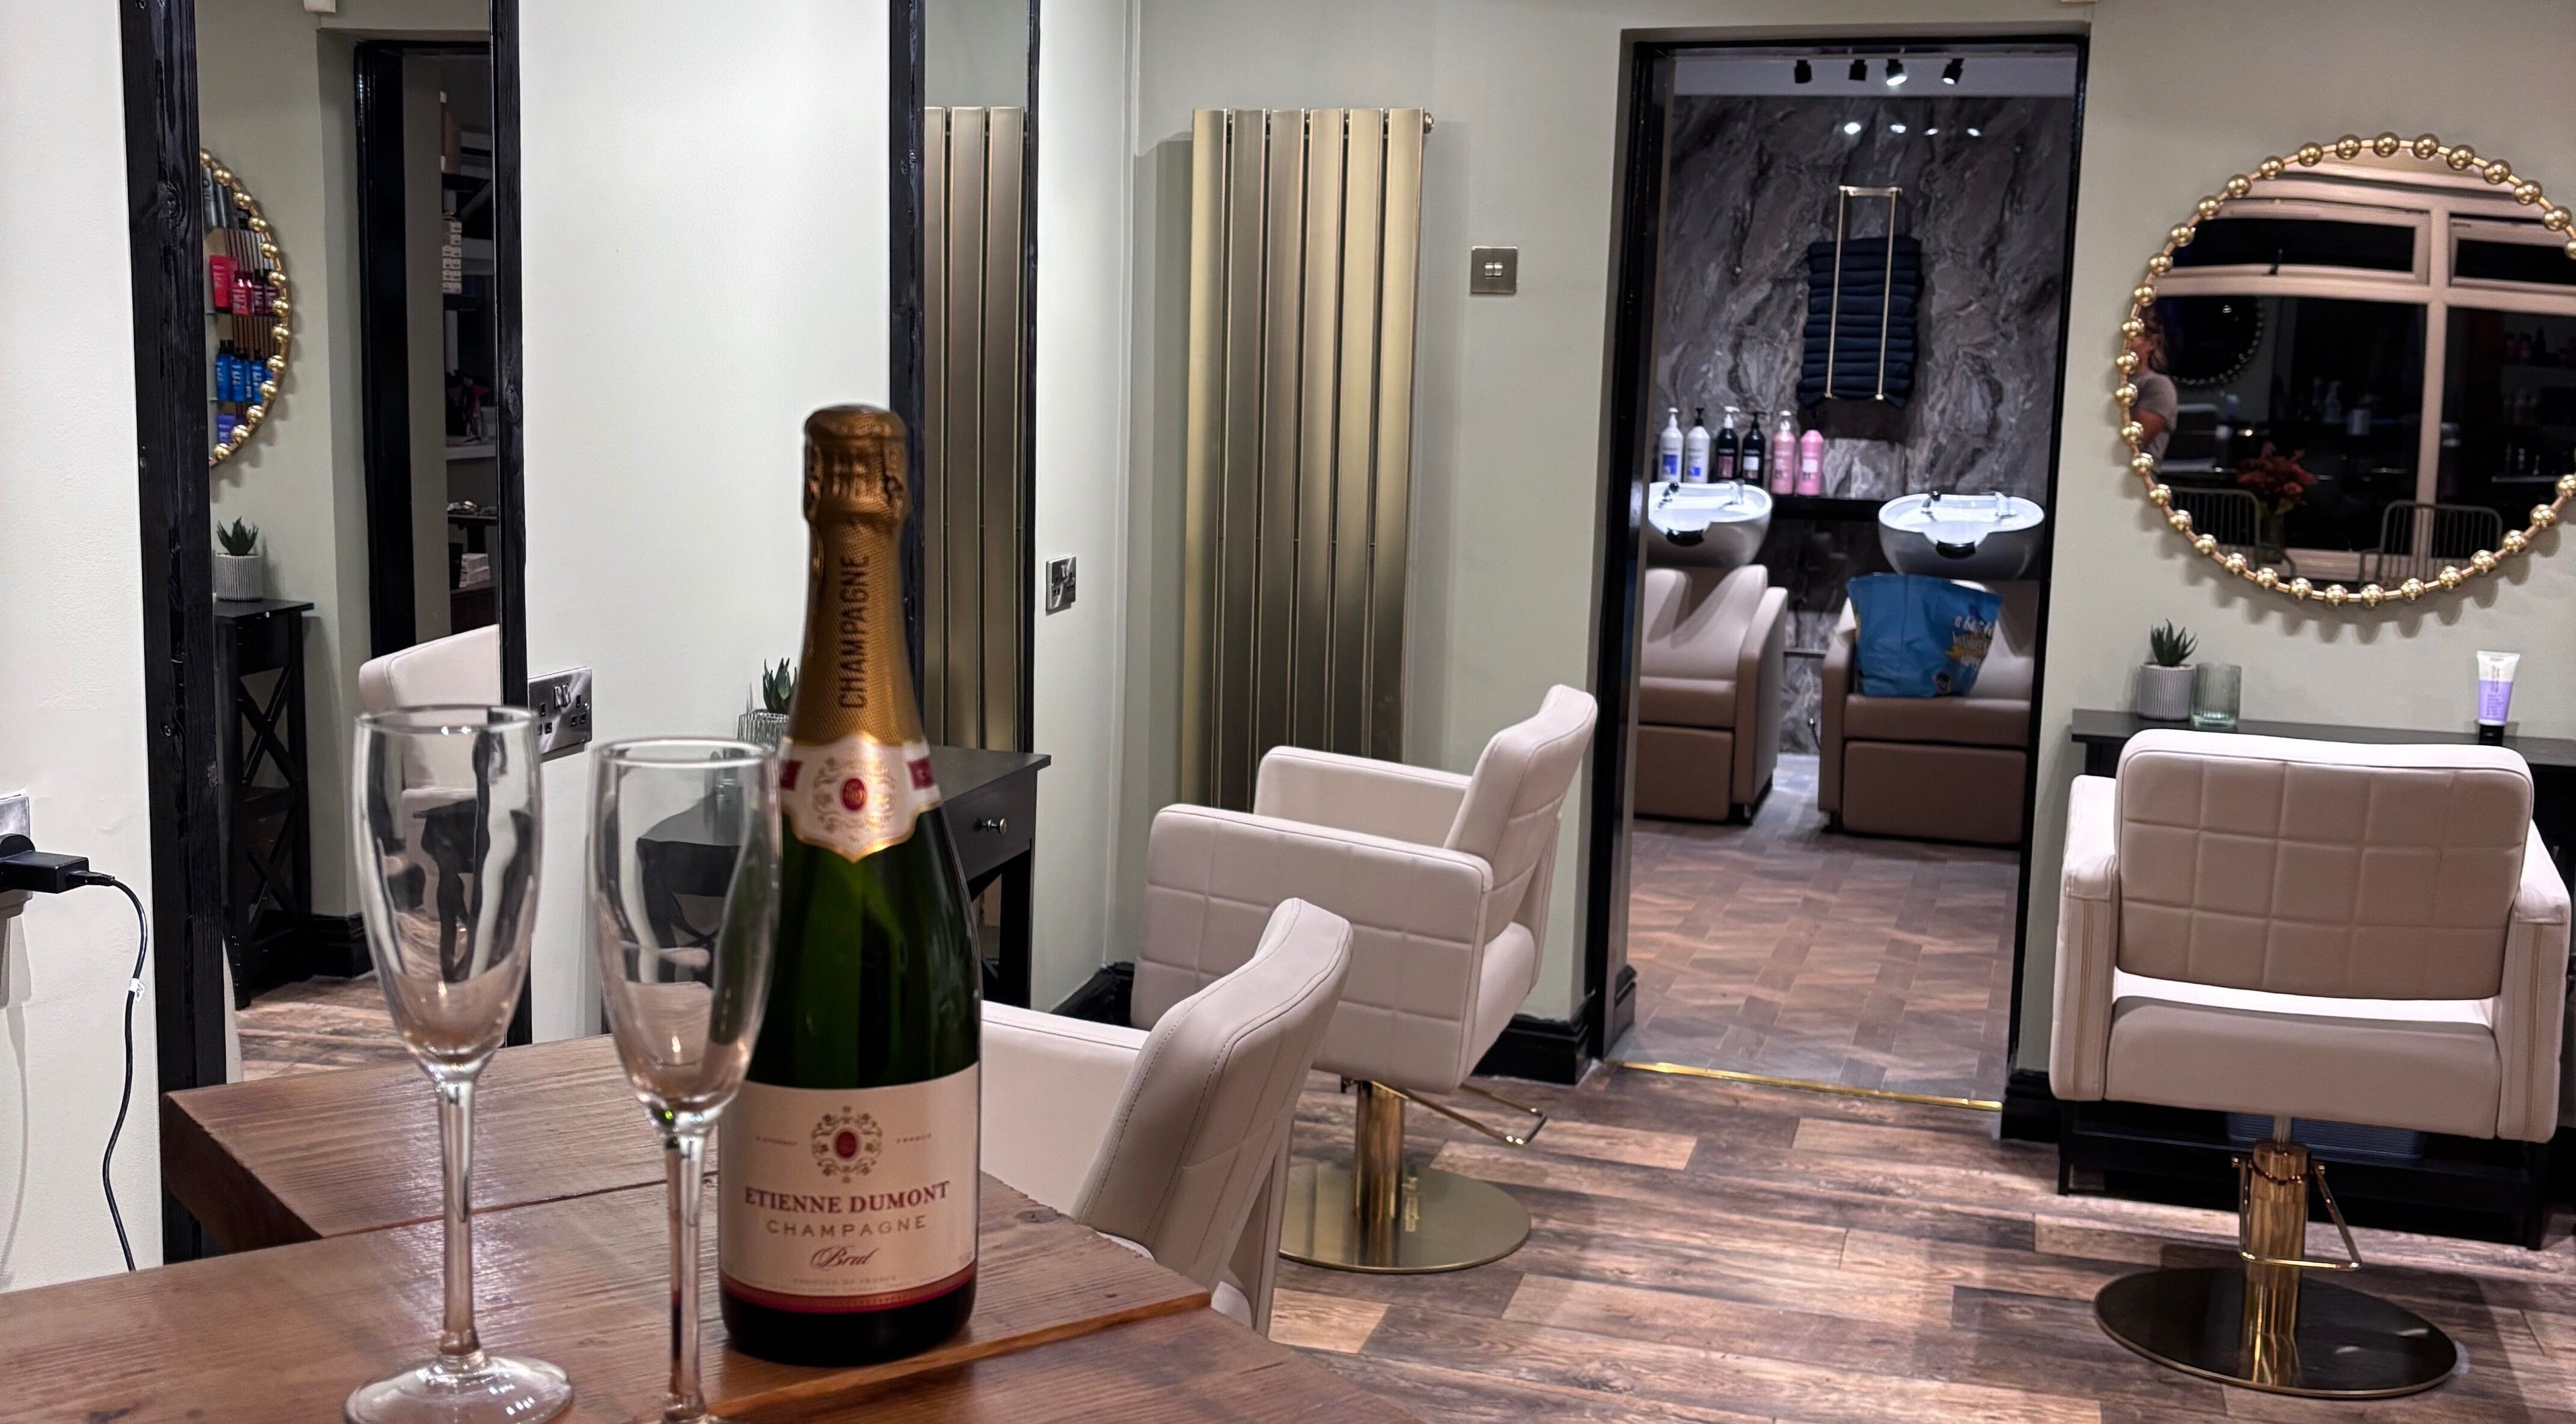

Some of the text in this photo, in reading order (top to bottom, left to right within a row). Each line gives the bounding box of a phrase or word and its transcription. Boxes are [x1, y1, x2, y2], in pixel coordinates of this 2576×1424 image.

[839, 555, 870, 709] CHAMPAGNE
[745, 1181, 950, 1214] ETIENNE DUMONT
[766, 1214, 927, 1238] CHAMPAGNE
[809, 1244, 880, 1272] Brut
